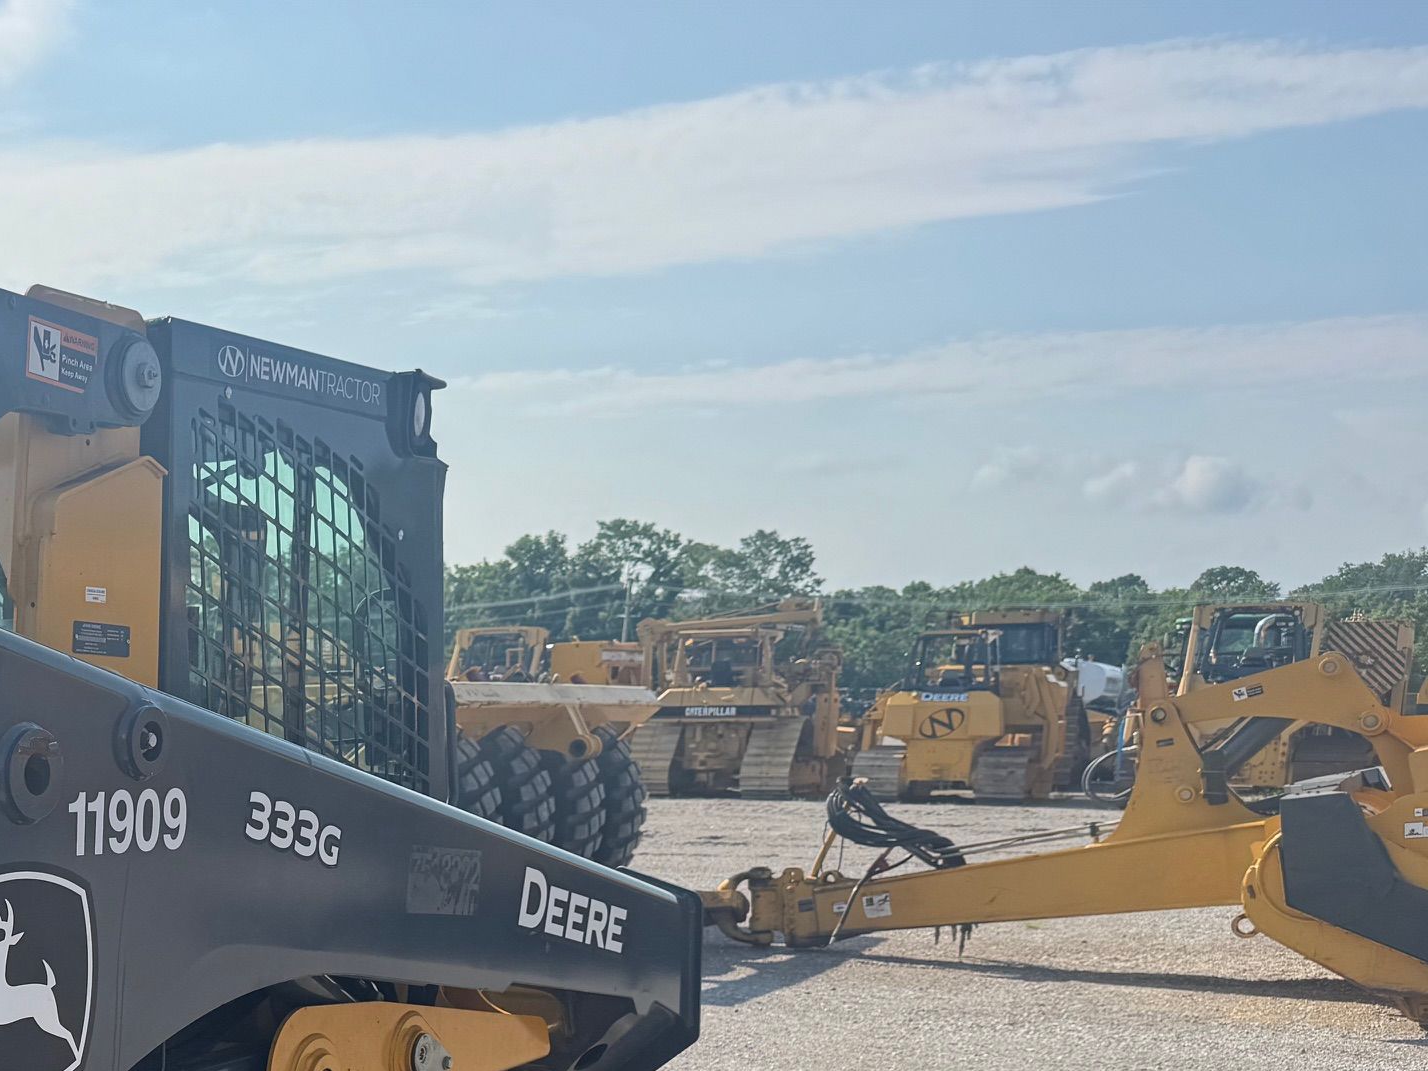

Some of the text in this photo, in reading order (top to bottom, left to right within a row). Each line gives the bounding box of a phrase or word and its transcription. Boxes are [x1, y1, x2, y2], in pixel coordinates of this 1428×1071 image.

[61, 367, 75, 378] Keep
[62, 354, 93, 372] Pinch Area
[68, 787, 188, 856] 11909
[245, 791, 342, 866] 333G
[518, 866, 628, 954] DEERE
